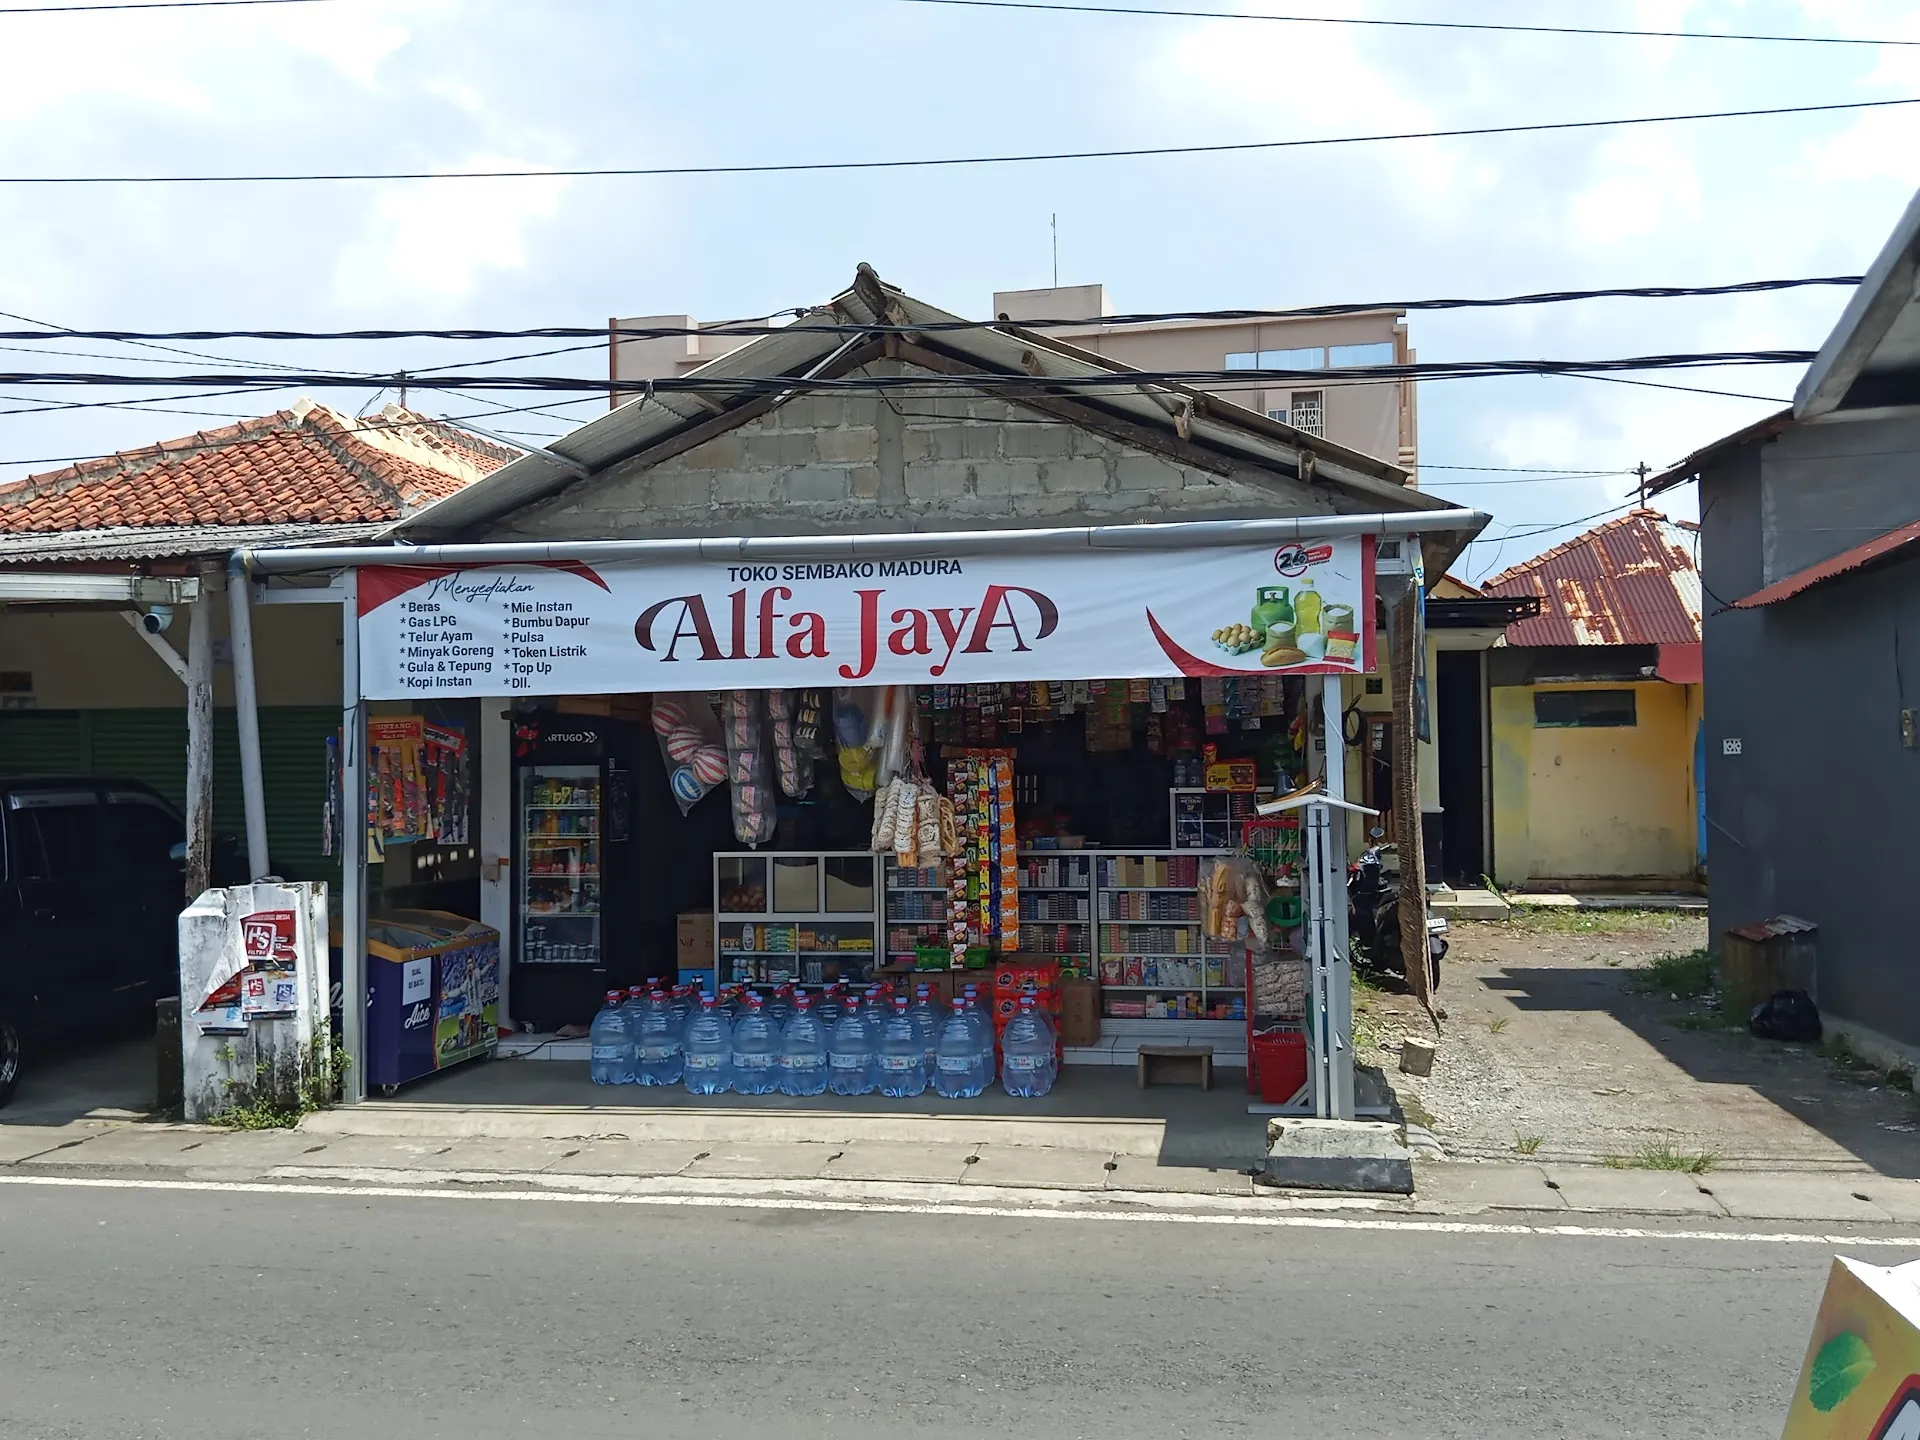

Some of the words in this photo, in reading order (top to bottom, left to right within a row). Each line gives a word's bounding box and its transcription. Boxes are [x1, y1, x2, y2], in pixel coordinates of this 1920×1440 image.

[728, 567, 778, 582] TOKO
[782, 562, 874, 580] SEMBAKO
[878, 560, 963, 577] MADURA
[428, 572, 535, 602] Menyediakan
[408, 602, 441, 613] Beras
[511, 602, 533, 613] Mie
[536, 601, 573, 612] Instan
[408, 616, 431, 627] Gas
[434, 616, 457, 627] LPG
[512, 616, 553, 628] Bumbu
[556, 616, 591, 628] Dapur
[634, 586, 830, 662] Alfa
[408, 631, 439, 642] Telur
[441, 631, 473, 643] Ayam
[511, 632, 544, 643] Pulsa
[408, 646, 450, 659] Minyak
[452, 646, 494, 658] Goreng
[512, 647, 547, 658] Token
[550, 645, 587, 657] Listrik
[408, 661, 435, 672] Gula
[438, 661, 446, 672] &
[448, 661, 492, 673] Tepung
[512, 663, 534, 675] Top
[537, 662, 552, 675] Up
[408, 677, 433, 689] Kopi
[436, 676, 472, 687] Instan
[512, 677, 531, 689] Dll.
[247, 926, 270, 950] HS
[249, 980, 263, 991] HS
[278, 985, 291, 997] HS
[404, 1003, 430, 1029] Aice
